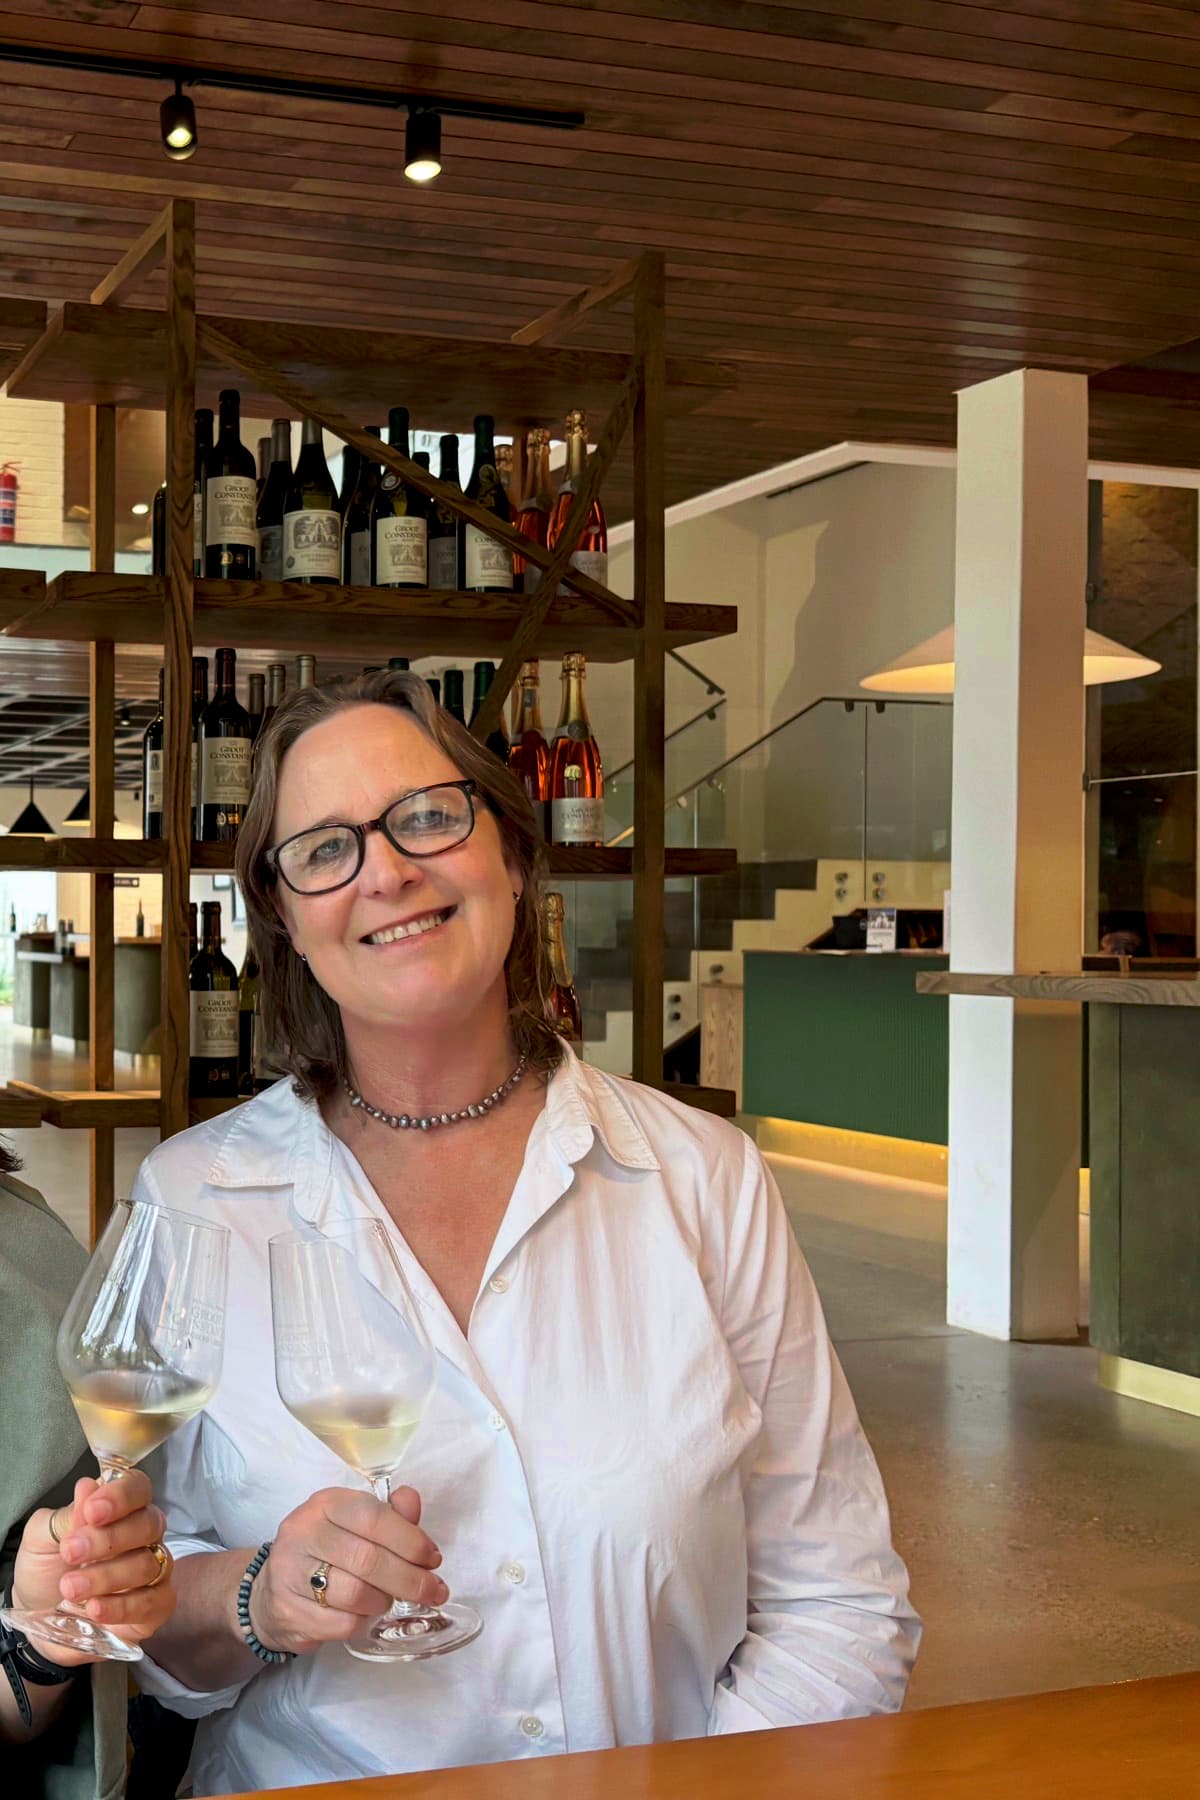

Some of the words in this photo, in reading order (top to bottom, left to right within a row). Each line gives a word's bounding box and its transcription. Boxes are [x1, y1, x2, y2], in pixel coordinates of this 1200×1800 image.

[224, 484, 249, 494] GROOT
[394, 525, 419, 534] GROOT
[220, 746, 245, 754] GROOT
[207, 999, 232, 1007] GROOT
